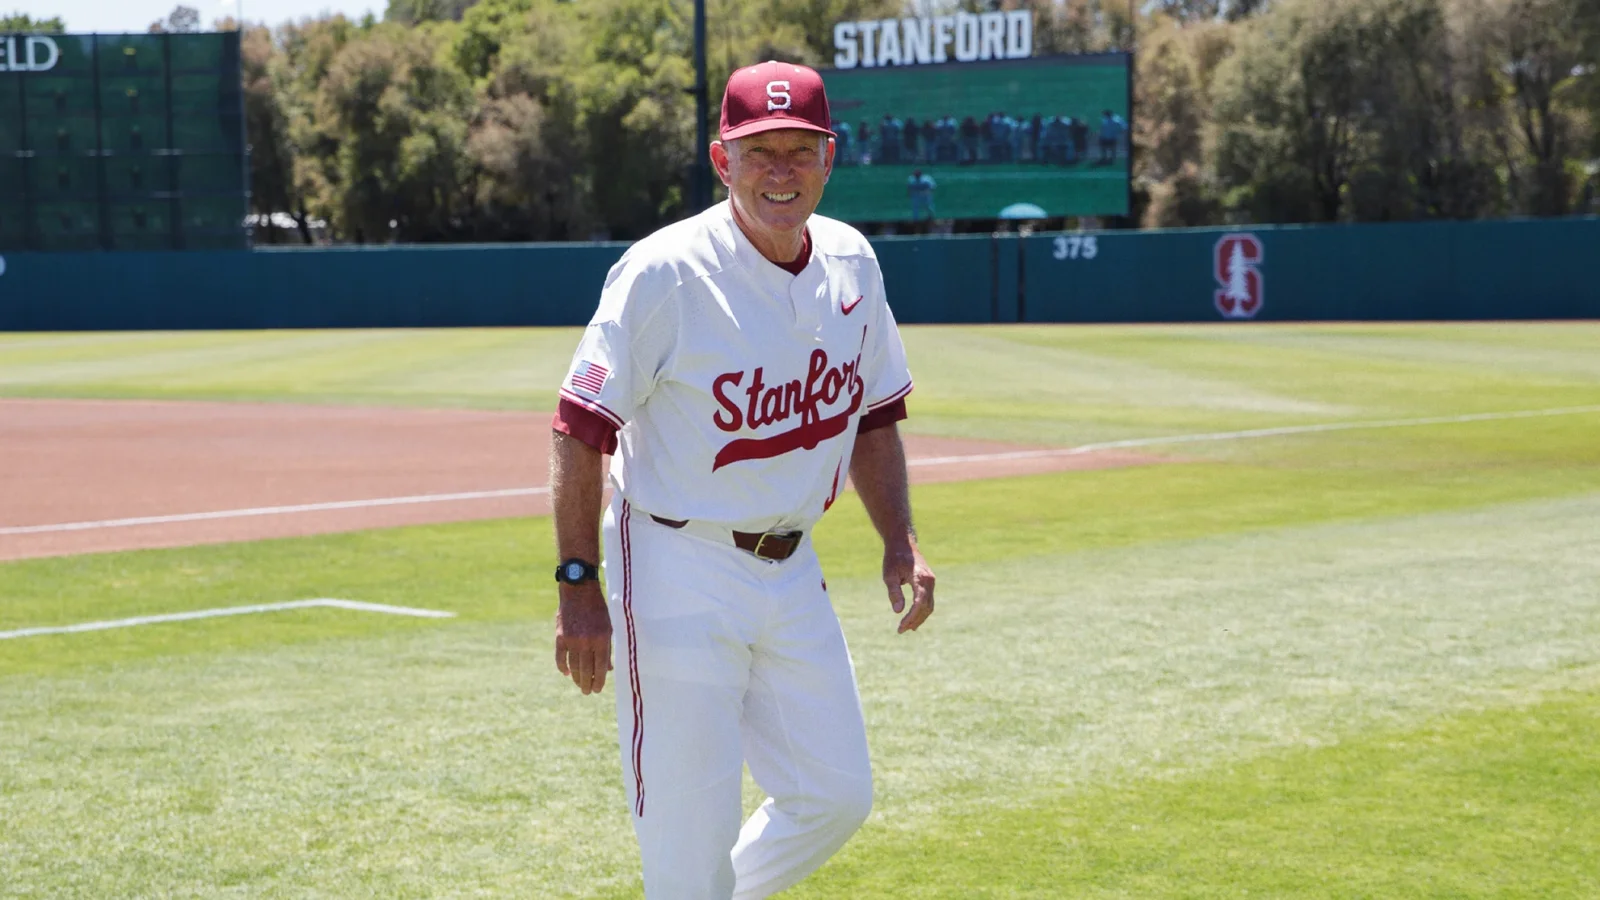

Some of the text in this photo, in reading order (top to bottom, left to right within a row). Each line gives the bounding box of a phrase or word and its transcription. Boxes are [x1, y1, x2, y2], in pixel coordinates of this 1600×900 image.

[834, 9, 1033, 69] STANFORD
[766, 80, 791, 111] S
[1053, 236, 1098, 260] 375
